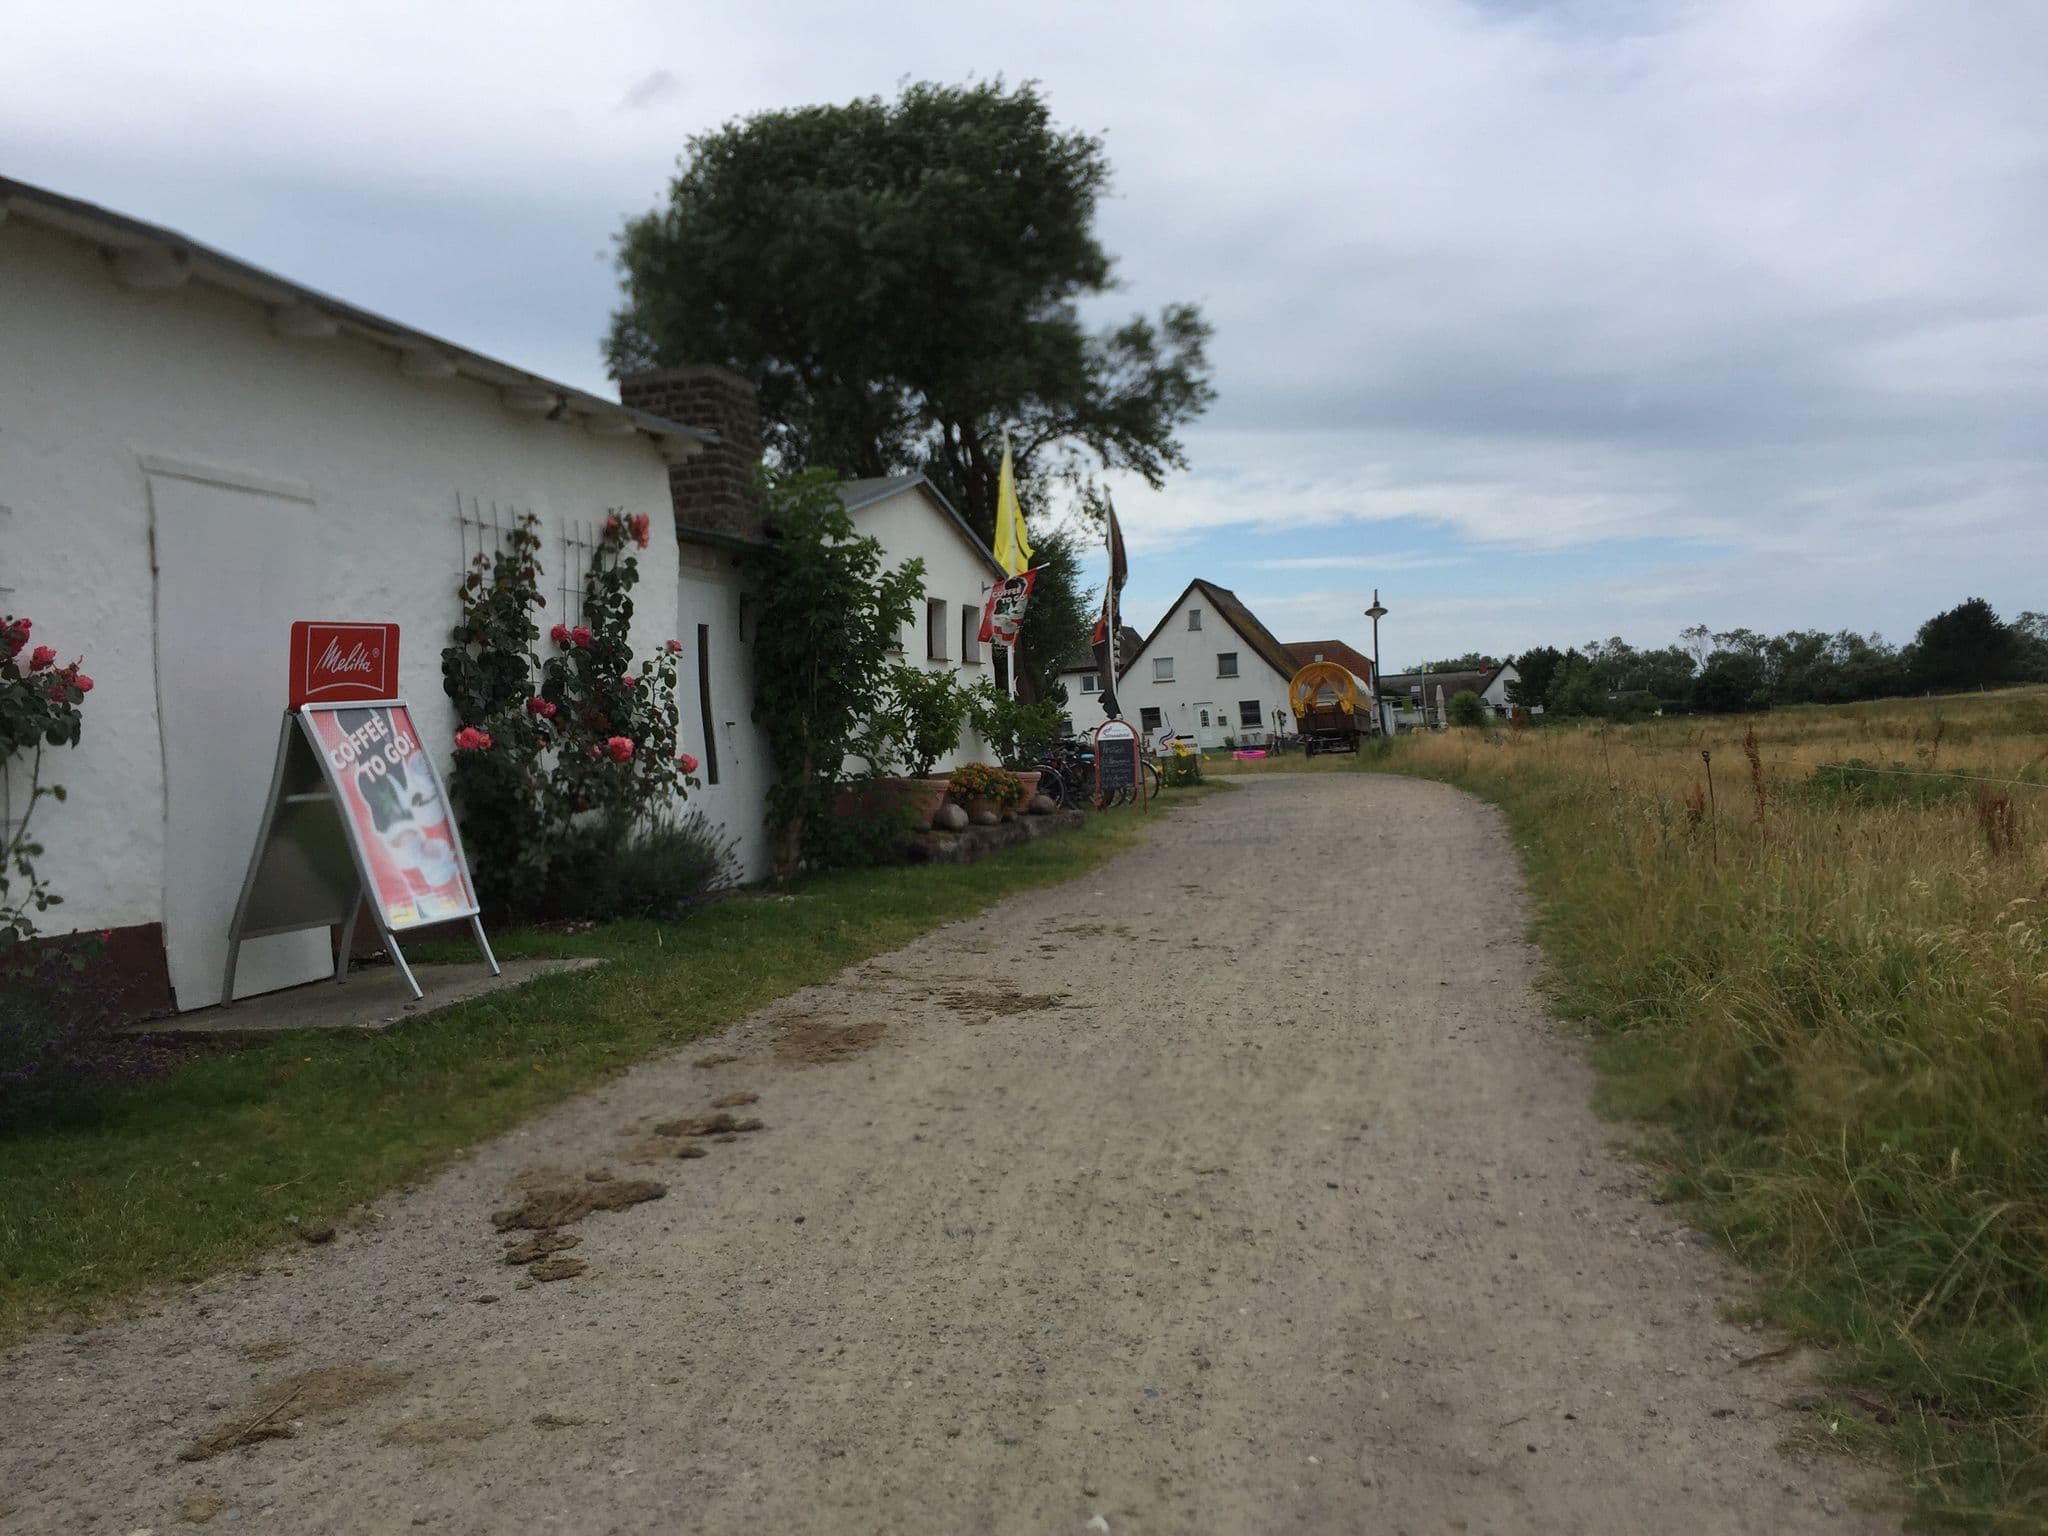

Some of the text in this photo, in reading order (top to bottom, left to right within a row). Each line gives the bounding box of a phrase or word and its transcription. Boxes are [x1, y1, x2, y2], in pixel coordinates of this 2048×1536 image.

[992, 587, 1022, 598] COFFEE
[1001, 596, 1012, 604] TO
[330, 715, 389, 769] COFFEE
[359, 730, 415, 783] TO GO!
